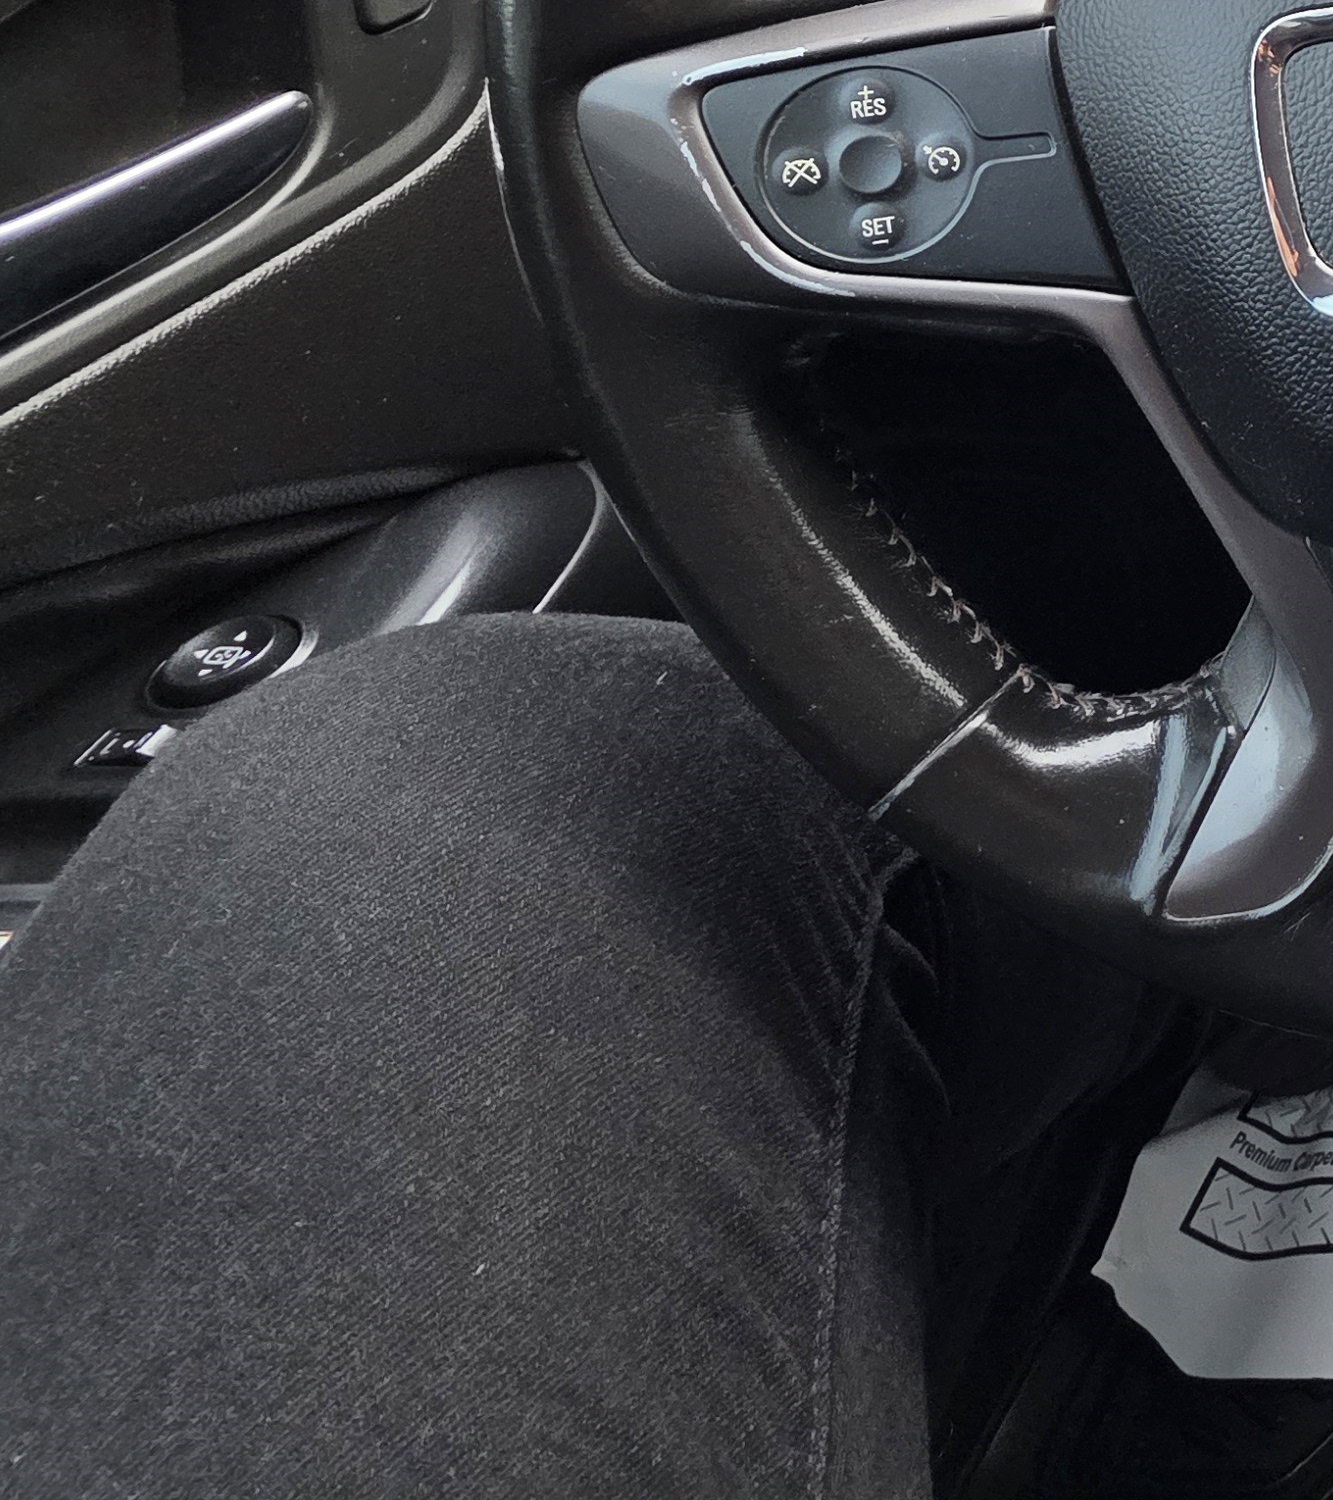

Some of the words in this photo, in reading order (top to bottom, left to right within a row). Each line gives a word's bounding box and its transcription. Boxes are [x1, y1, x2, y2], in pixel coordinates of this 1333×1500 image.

[849, 98, 887, 119] RES
[861, 215, 896, 237] SET
[1229, 1130, 1292, 1173] Premium
